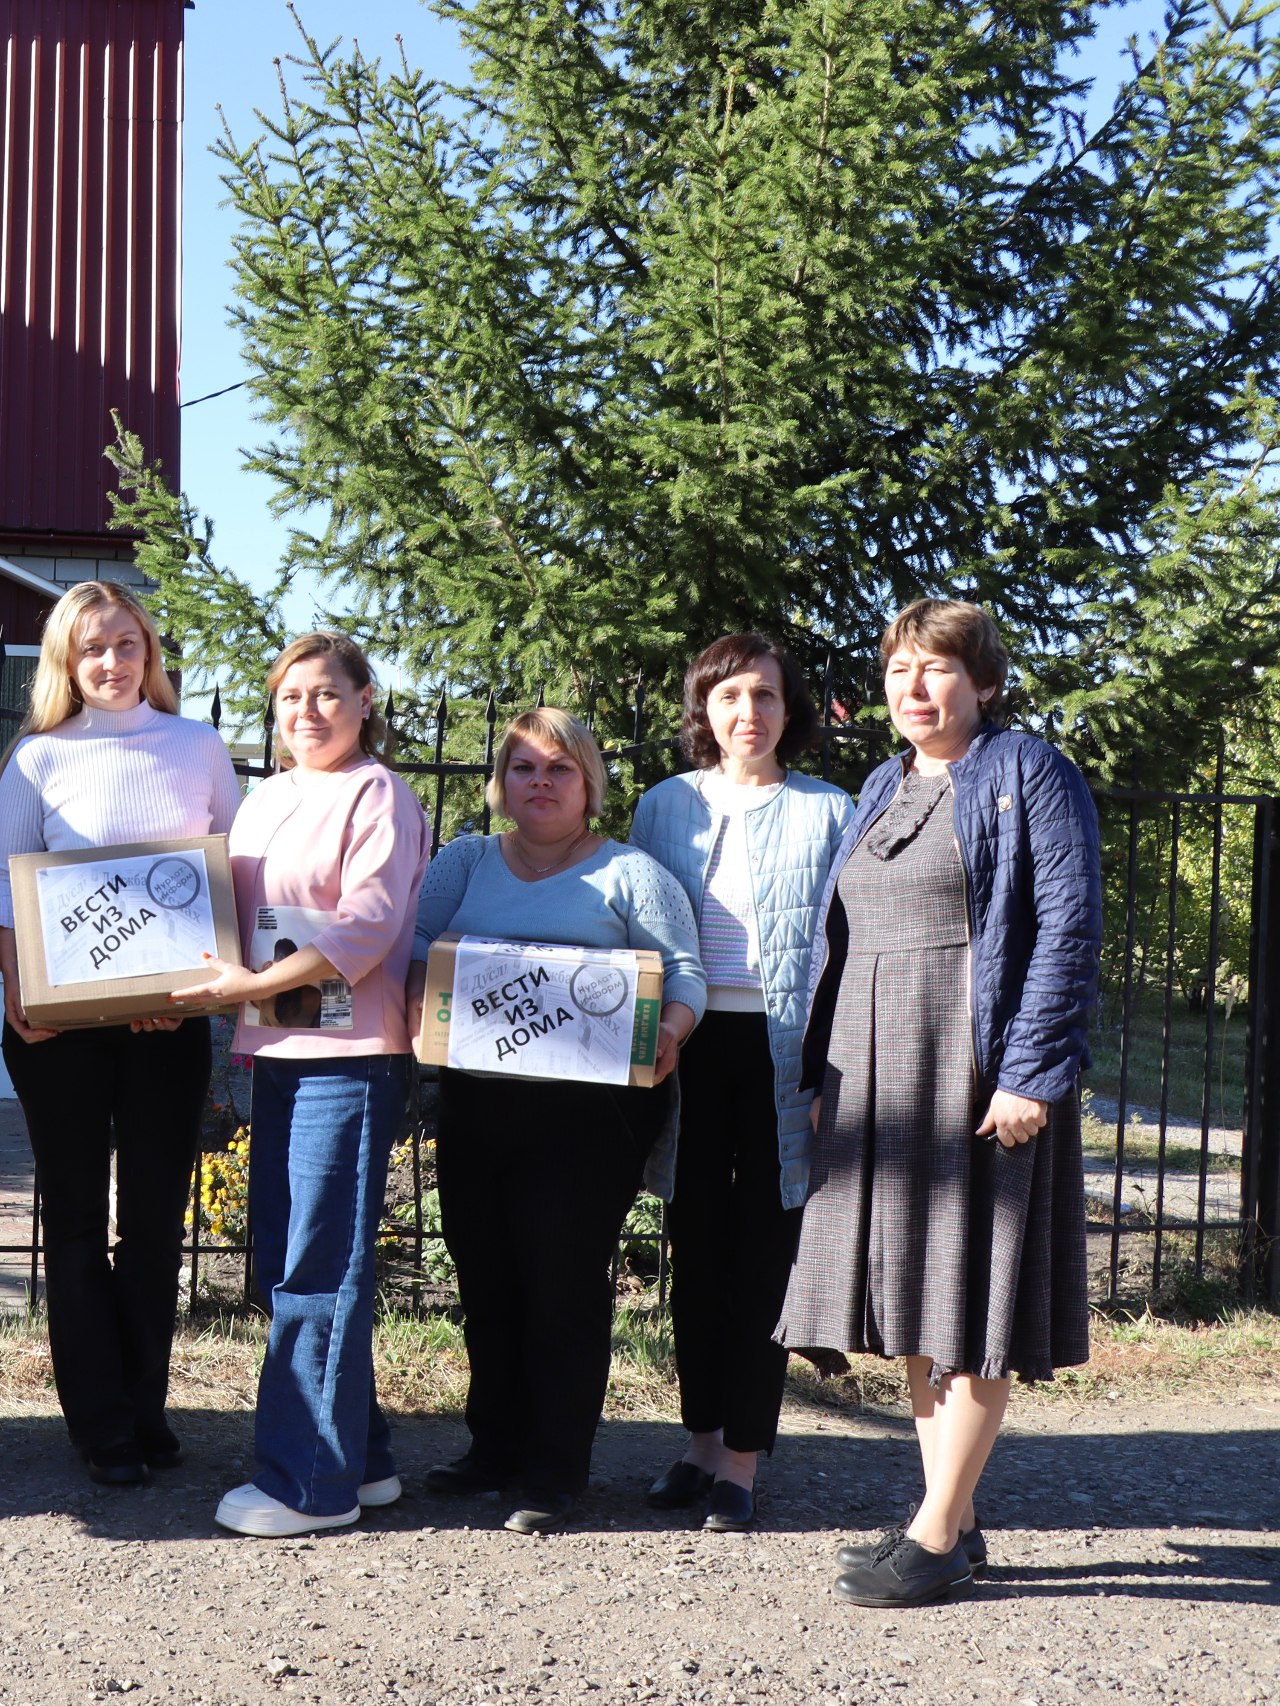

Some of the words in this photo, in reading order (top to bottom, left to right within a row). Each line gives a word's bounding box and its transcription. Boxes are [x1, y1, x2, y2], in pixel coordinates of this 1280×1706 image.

[60, 873, 127, 934] ВЕСТИ
[91, 905, 123, 934] ИЗ
[89, 907, 157, 970] ДОМА
[471, 966, 550, 1018] ВЕСТИ
[504, 997, 539, 1026] ИЗ
[495, 1007, 574, 1061] ДОМА
